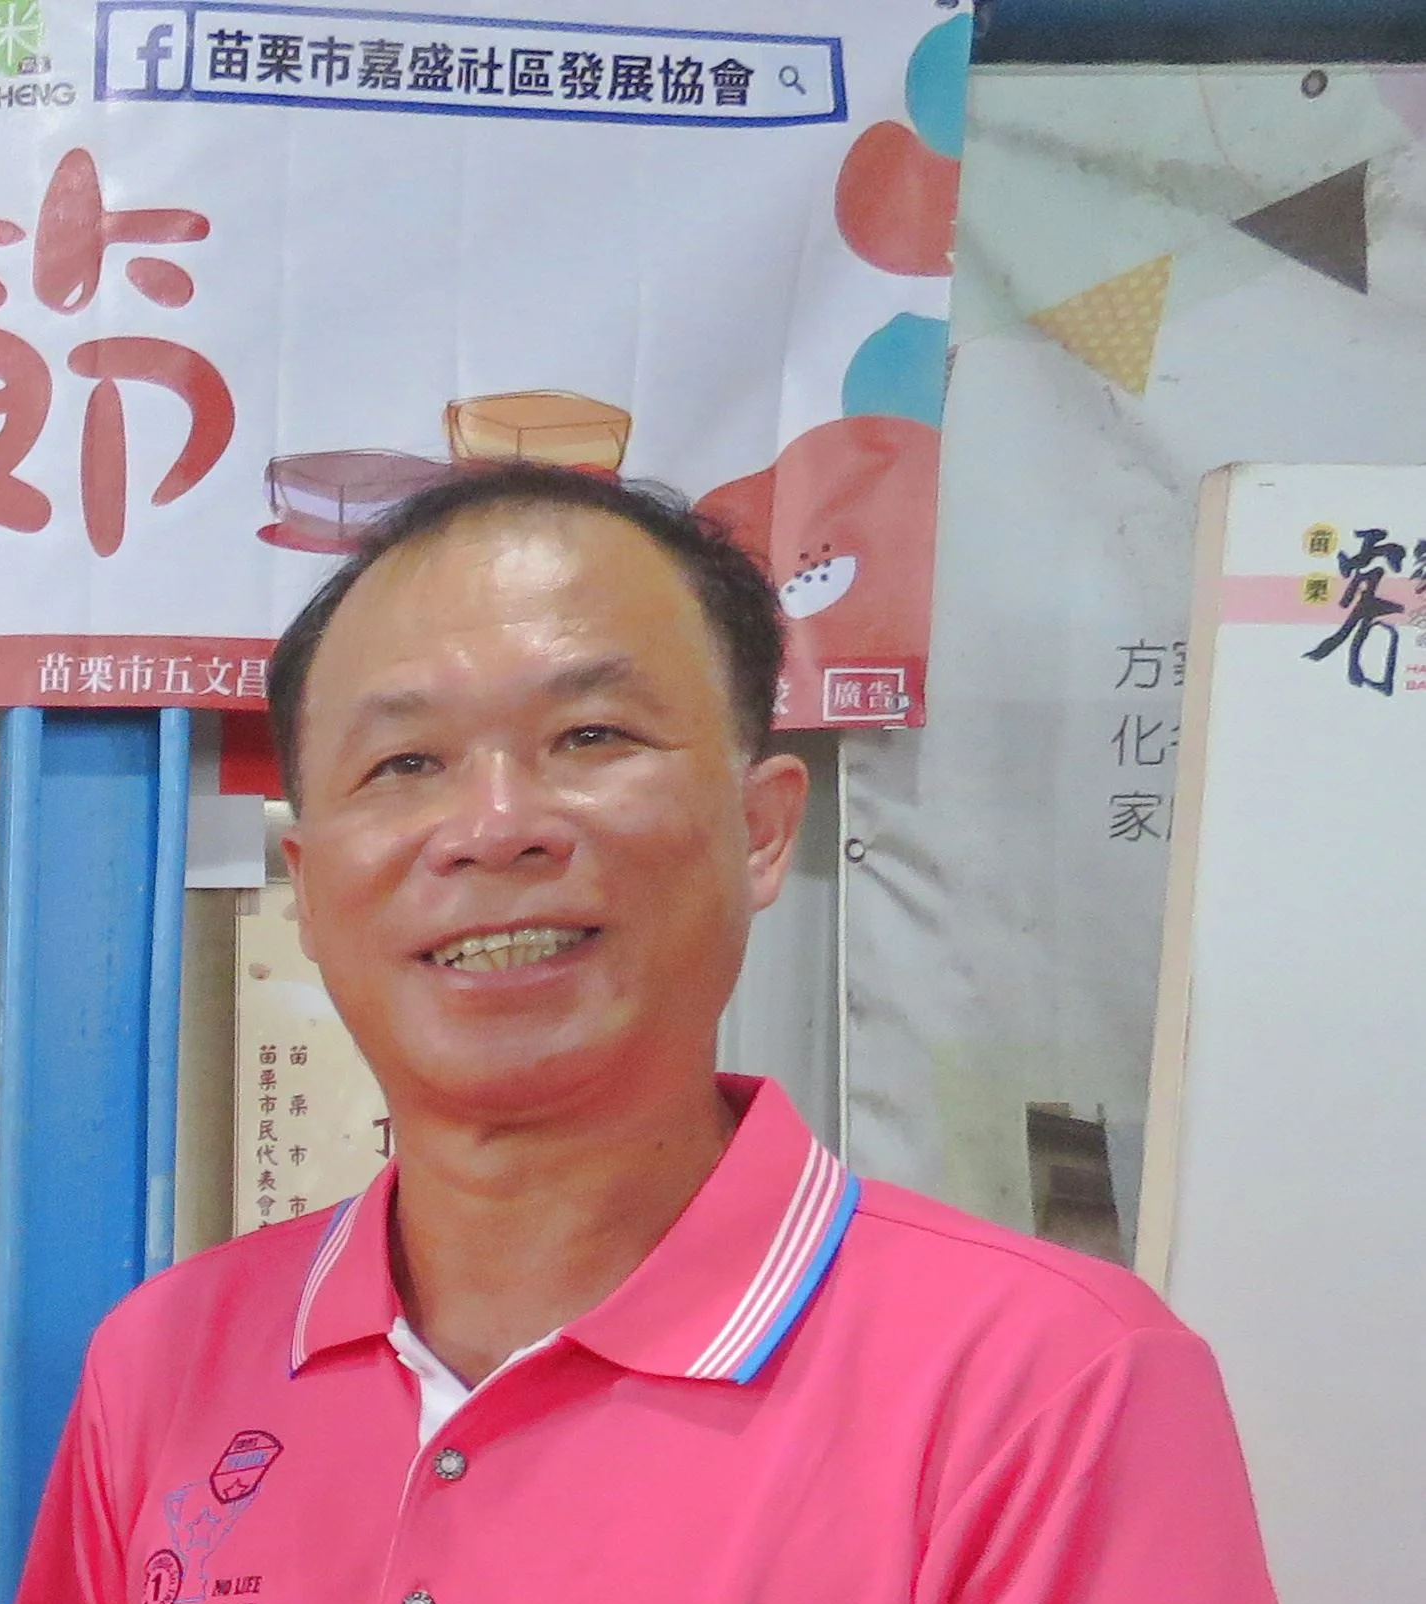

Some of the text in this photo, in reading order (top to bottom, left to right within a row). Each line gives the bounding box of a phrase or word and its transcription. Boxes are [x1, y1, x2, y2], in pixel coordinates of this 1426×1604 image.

[207, 29, 754, 107] 苗栗市嘉盛社區發展協會
[38, 653, 269, 698] 苗栗市五文昌
[833, 679, 906, 709] 廣告
[255, 1045, 279, 1229] 苗栗市民代表會
